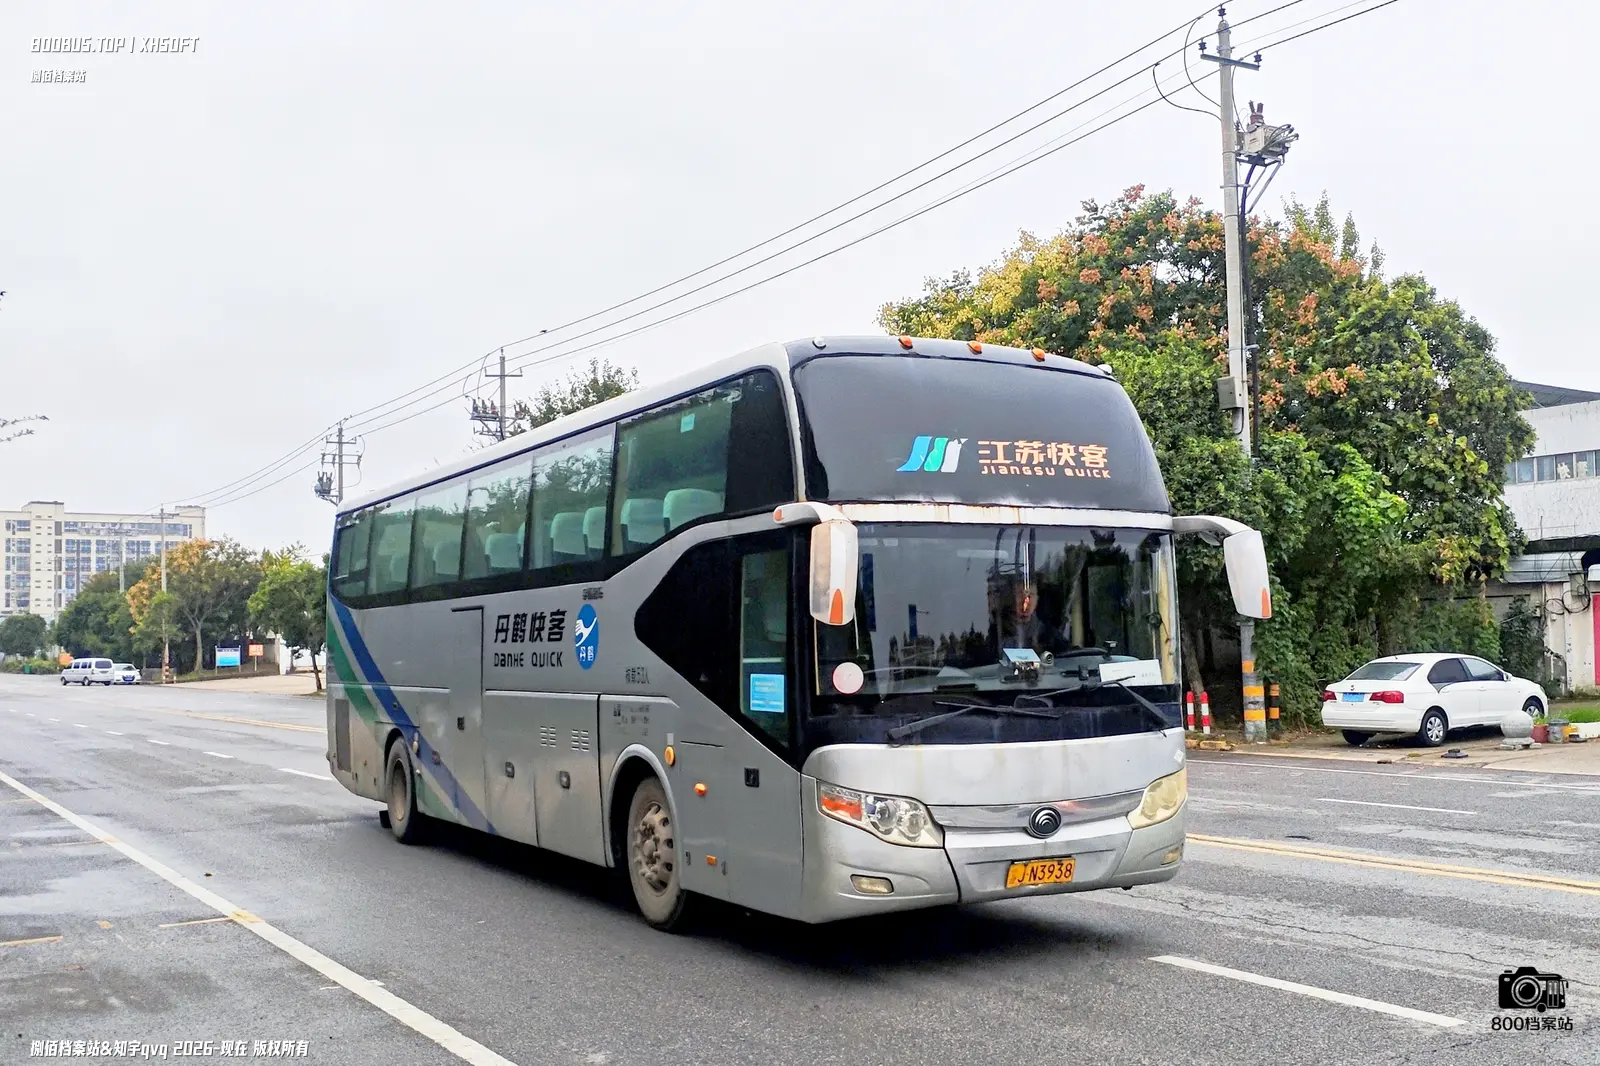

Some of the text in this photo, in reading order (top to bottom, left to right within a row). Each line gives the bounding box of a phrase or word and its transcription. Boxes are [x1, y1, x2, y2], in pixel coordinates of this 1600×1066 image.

[977, 440, 1109, 468] 江苏快客
[1064, 468, 1112, 479] QUICK
[494, 608, 567, 644] 丹鹤快客
[531, 650, 563, 667] QUICK
